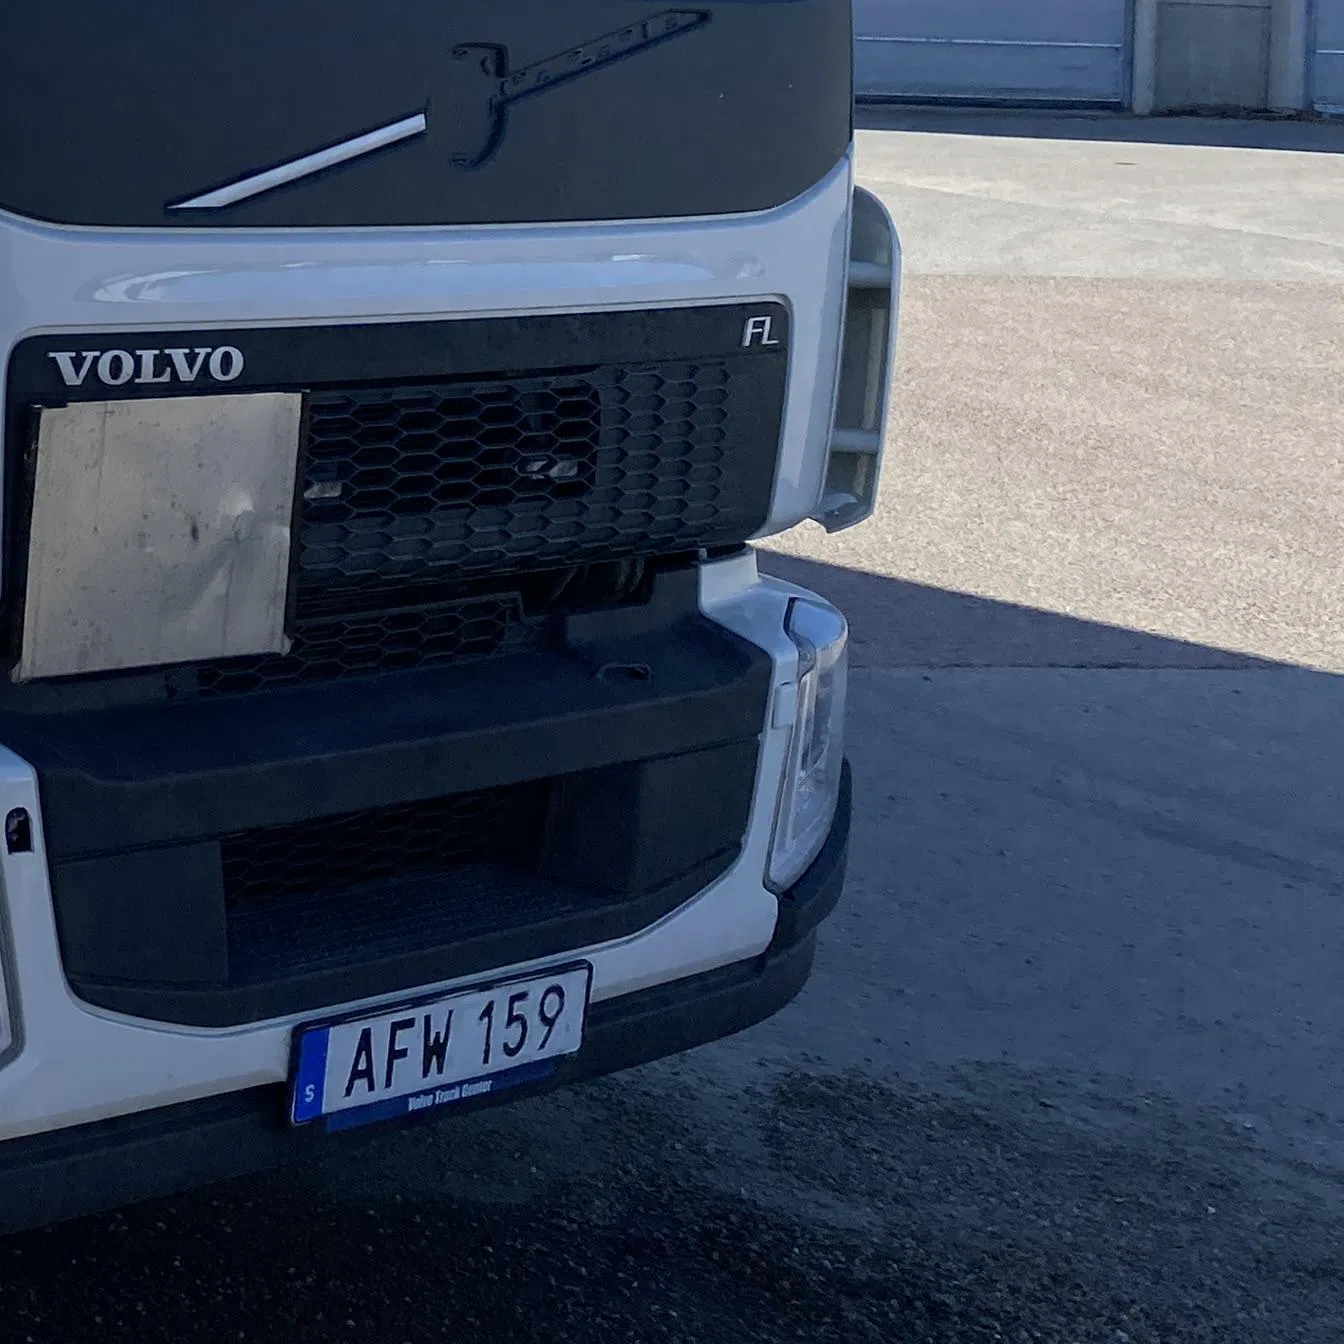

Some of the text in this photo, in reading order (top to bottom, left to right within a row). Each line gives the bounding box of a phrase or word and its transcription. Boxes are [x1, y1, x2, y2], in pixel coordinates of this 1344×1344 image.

[742, 316, 780, 346] FL
[48, 345, 245, 386] VOLVO
[343, 983, 566, 1098] AFW 159
[304, 1083, 315, 1103] S
